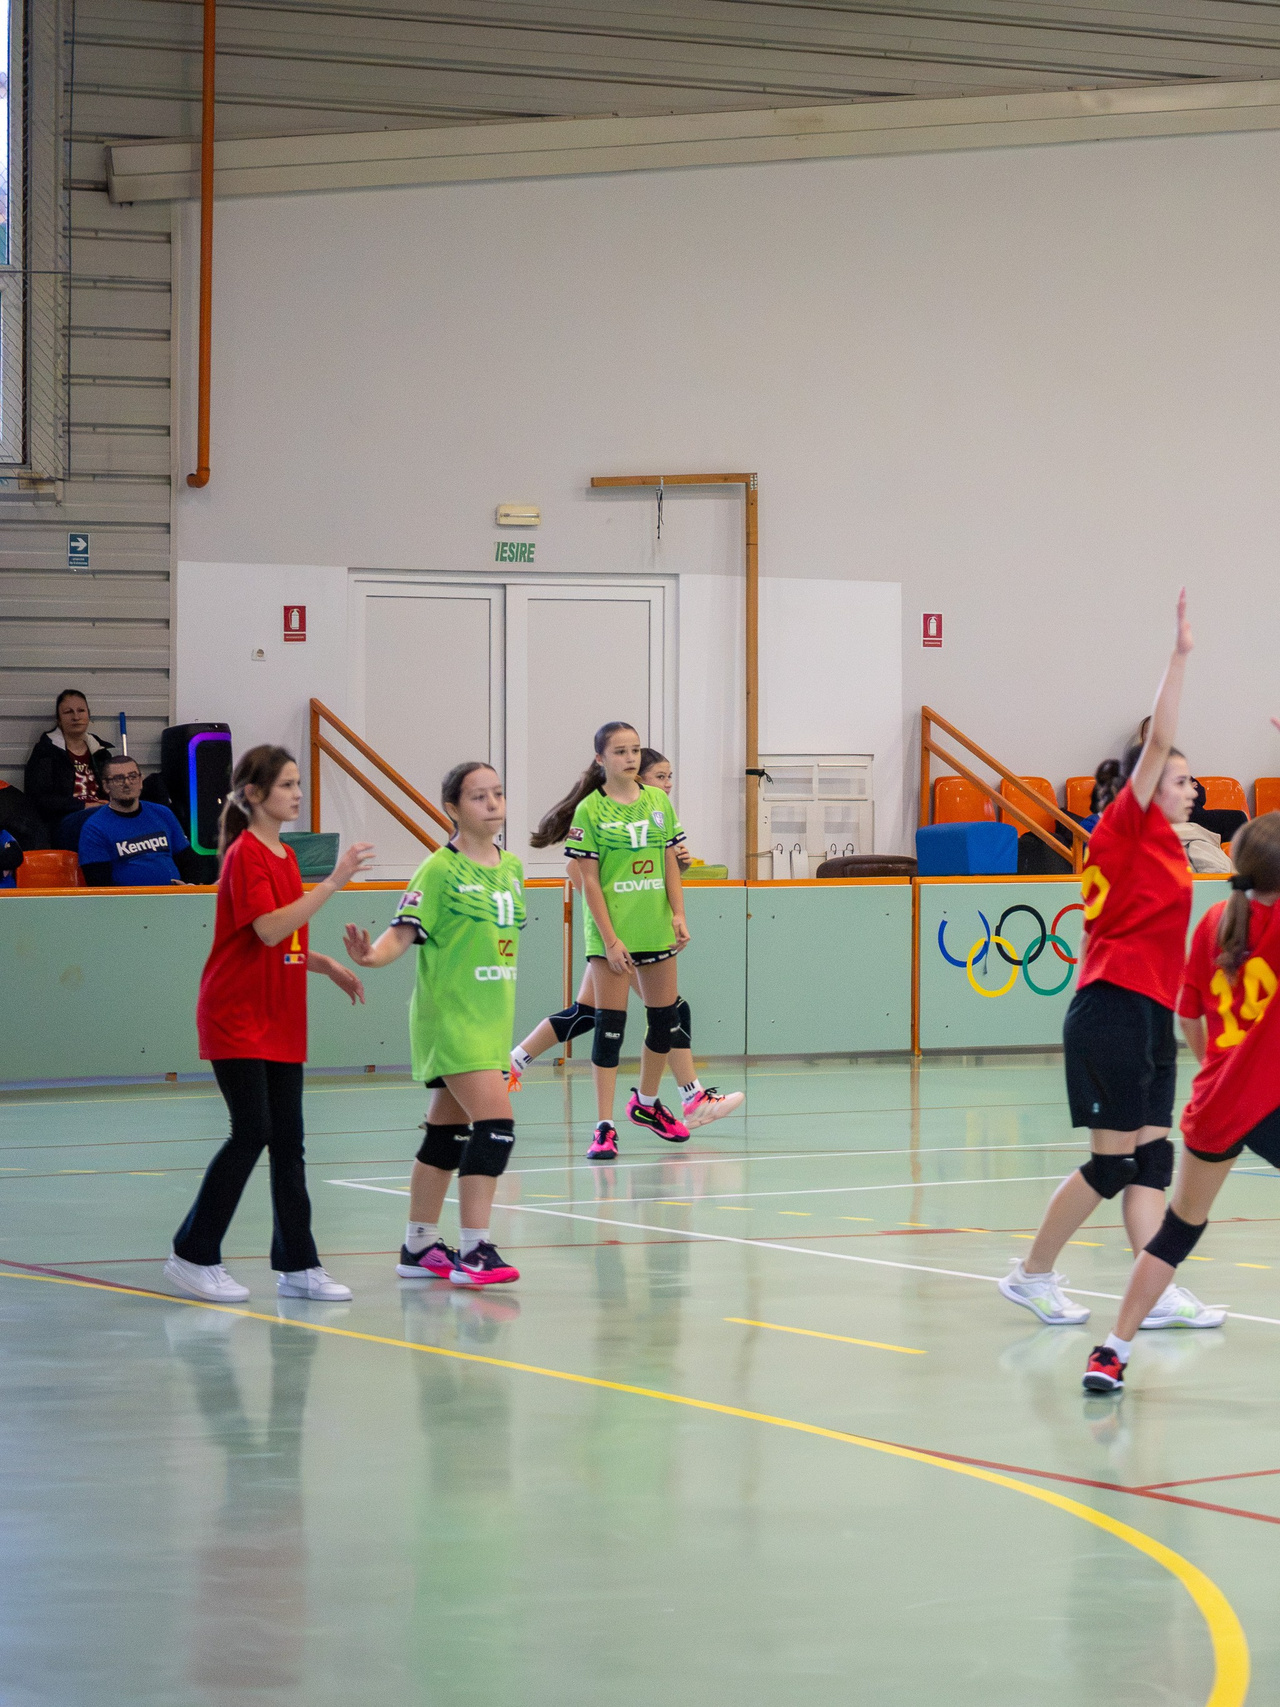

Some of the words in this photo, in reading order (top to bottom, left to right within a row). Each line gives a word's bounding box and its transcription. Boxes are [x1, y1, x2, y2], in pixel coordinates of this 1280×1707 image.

[495, 541, 536, 563] IESIRE
[116, 836, 169, 857] Kempa
[626, 819, 649, 849] 17
[492, 891, 515, 926] 11
